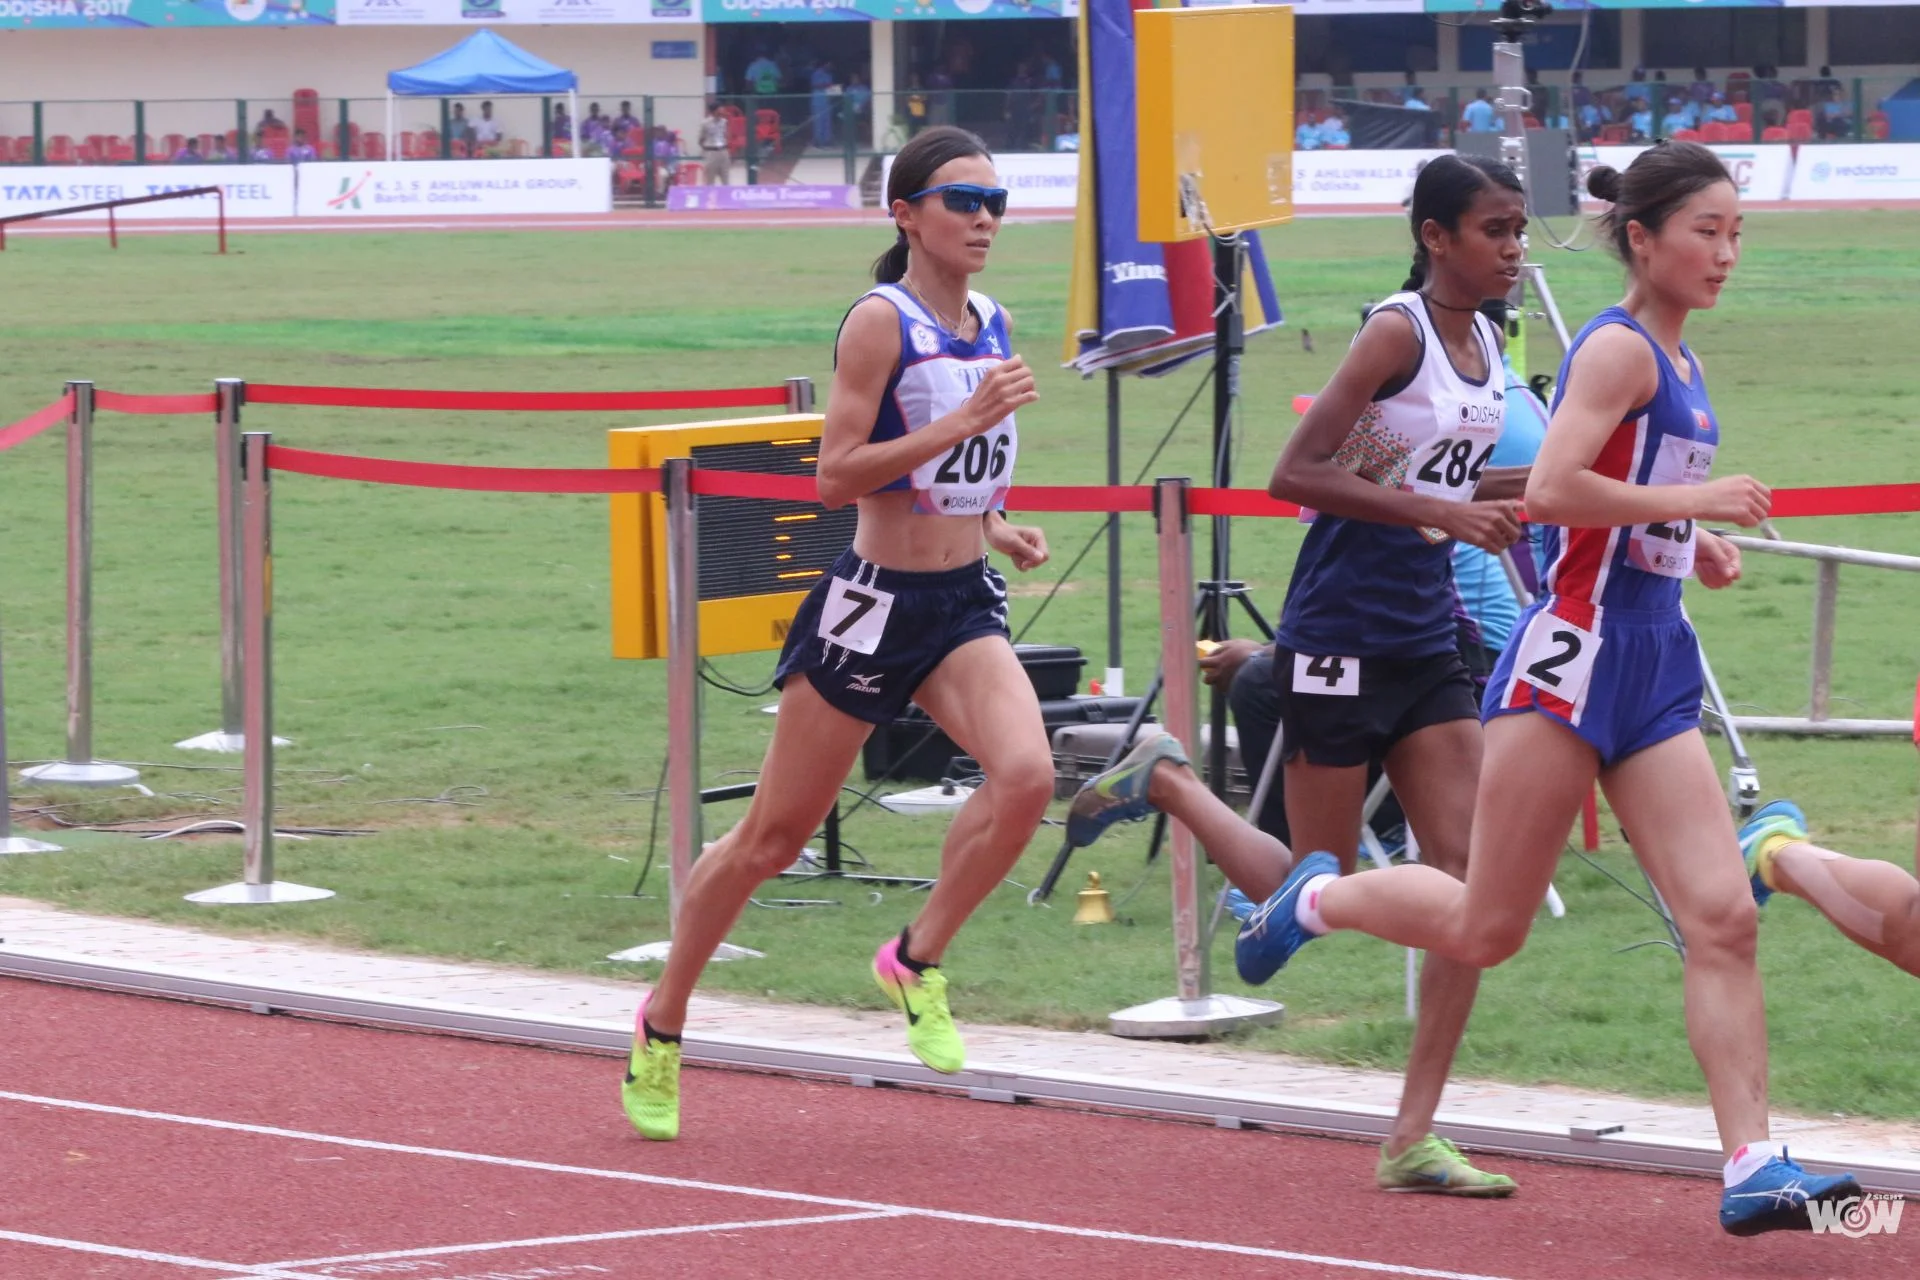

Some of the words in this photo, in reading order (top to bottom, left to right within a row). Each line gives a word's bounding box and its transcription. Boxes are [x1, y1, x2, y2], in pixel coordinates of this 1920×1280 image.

[1835, 163, 1898, 176] vedanta
[3, 185, 62, 200] TATA
[69, 185, 124, 199] STEEL
[731, 188, 776, 200] Odisha
[1459, 402, 1500, 424] ODISHA
[934, 434, 1010, 483] 206
[1416, 439, 1496, 488] 284
[830, 589, 878, 637] 7
[1306, 655, 1345, 687] 4
[1526, 630, 1582, 688] 2
